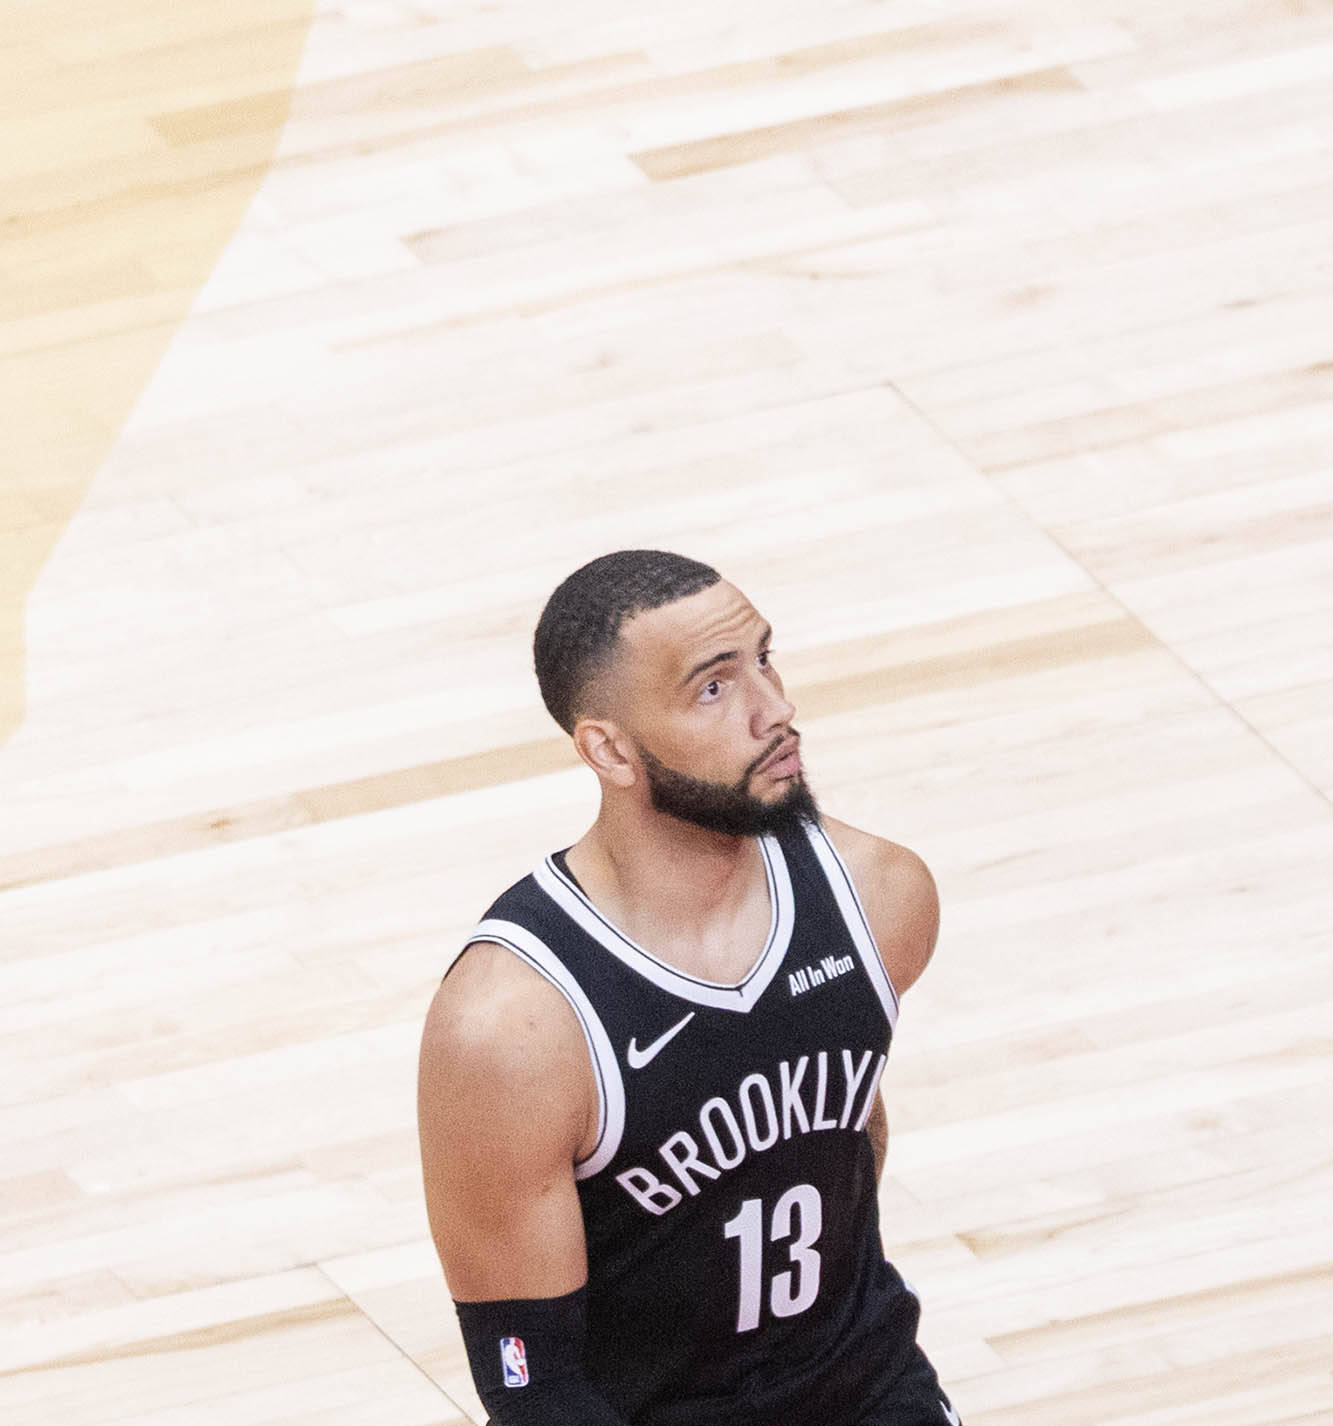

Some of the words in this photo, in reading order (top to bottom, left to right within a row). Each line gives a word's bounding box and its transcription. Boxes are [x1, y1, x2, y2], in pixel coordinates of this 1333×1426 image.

[788, 968, 810, 997] All
[806, 966, 826, 987] In
[820, 955, 855, 980] Won
[724, 1184, 823, 1334] 13
